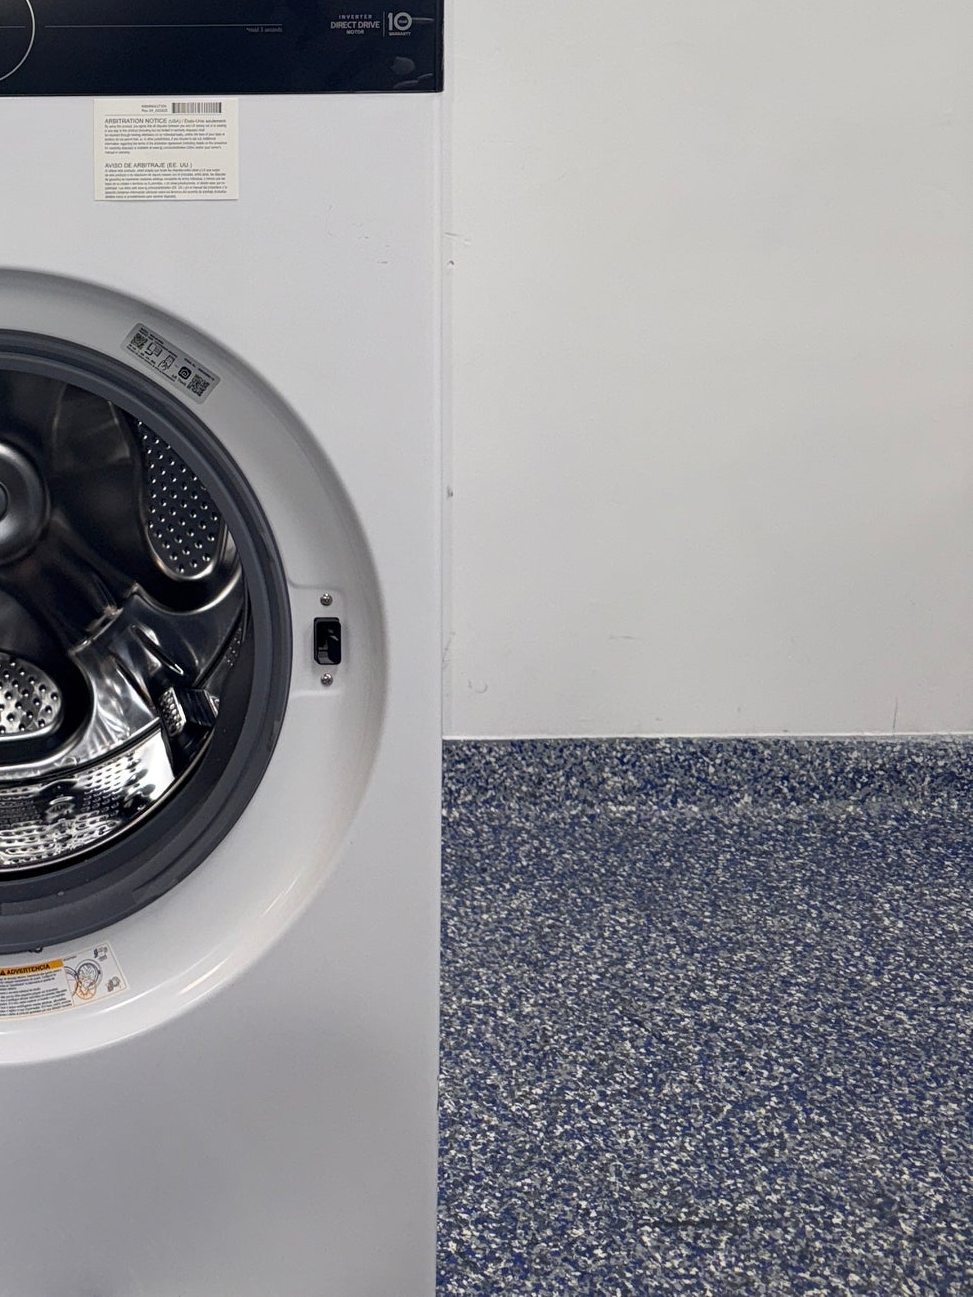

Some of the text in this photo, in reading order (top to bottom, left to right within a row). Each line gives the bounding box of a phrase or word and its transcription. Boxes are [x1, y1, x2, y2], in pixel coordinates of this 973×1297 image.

[330, 21, 380, 29] DIRECT DRIVE
[388, 12, 413, 31] 10
[7, 964, 50, 976] ADVERTENCIA
